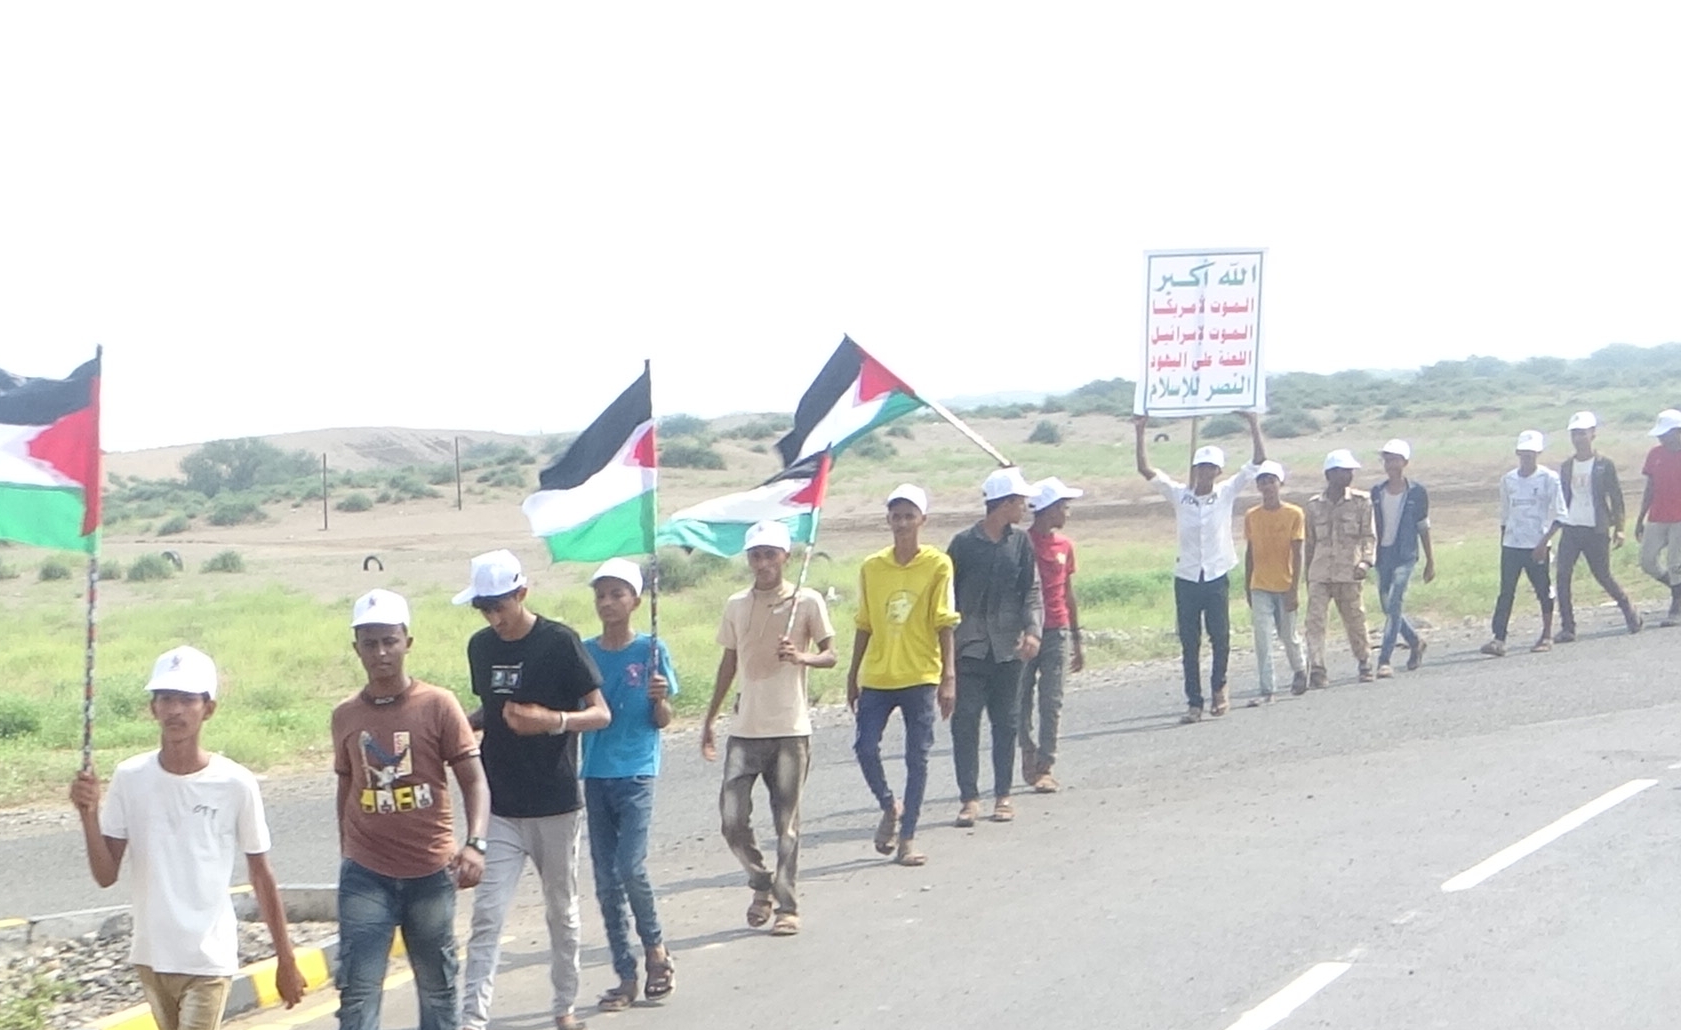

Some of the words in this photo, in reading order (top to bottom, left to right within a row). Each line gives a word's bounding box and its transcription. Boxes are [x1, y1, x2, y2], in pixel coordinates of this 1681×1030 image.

[1154, 258, 1216, 295] أكبر
[1152, 294, 1205, 318] لأمريكا
[1210, 298, 1254, 317] الموت
[1150, 325, 1204, 346] لإسرائيل
[1209, 325, 1253, 344] الموت
[1150, 352, 1187, 372] اليهود
[1192, 353, 1212, 371] على
[1219, 351, 1251, 366] اللعنة
[1150, 375, 1200, 404] للإسلام
[1205, 373, 1251, 402] النصر
